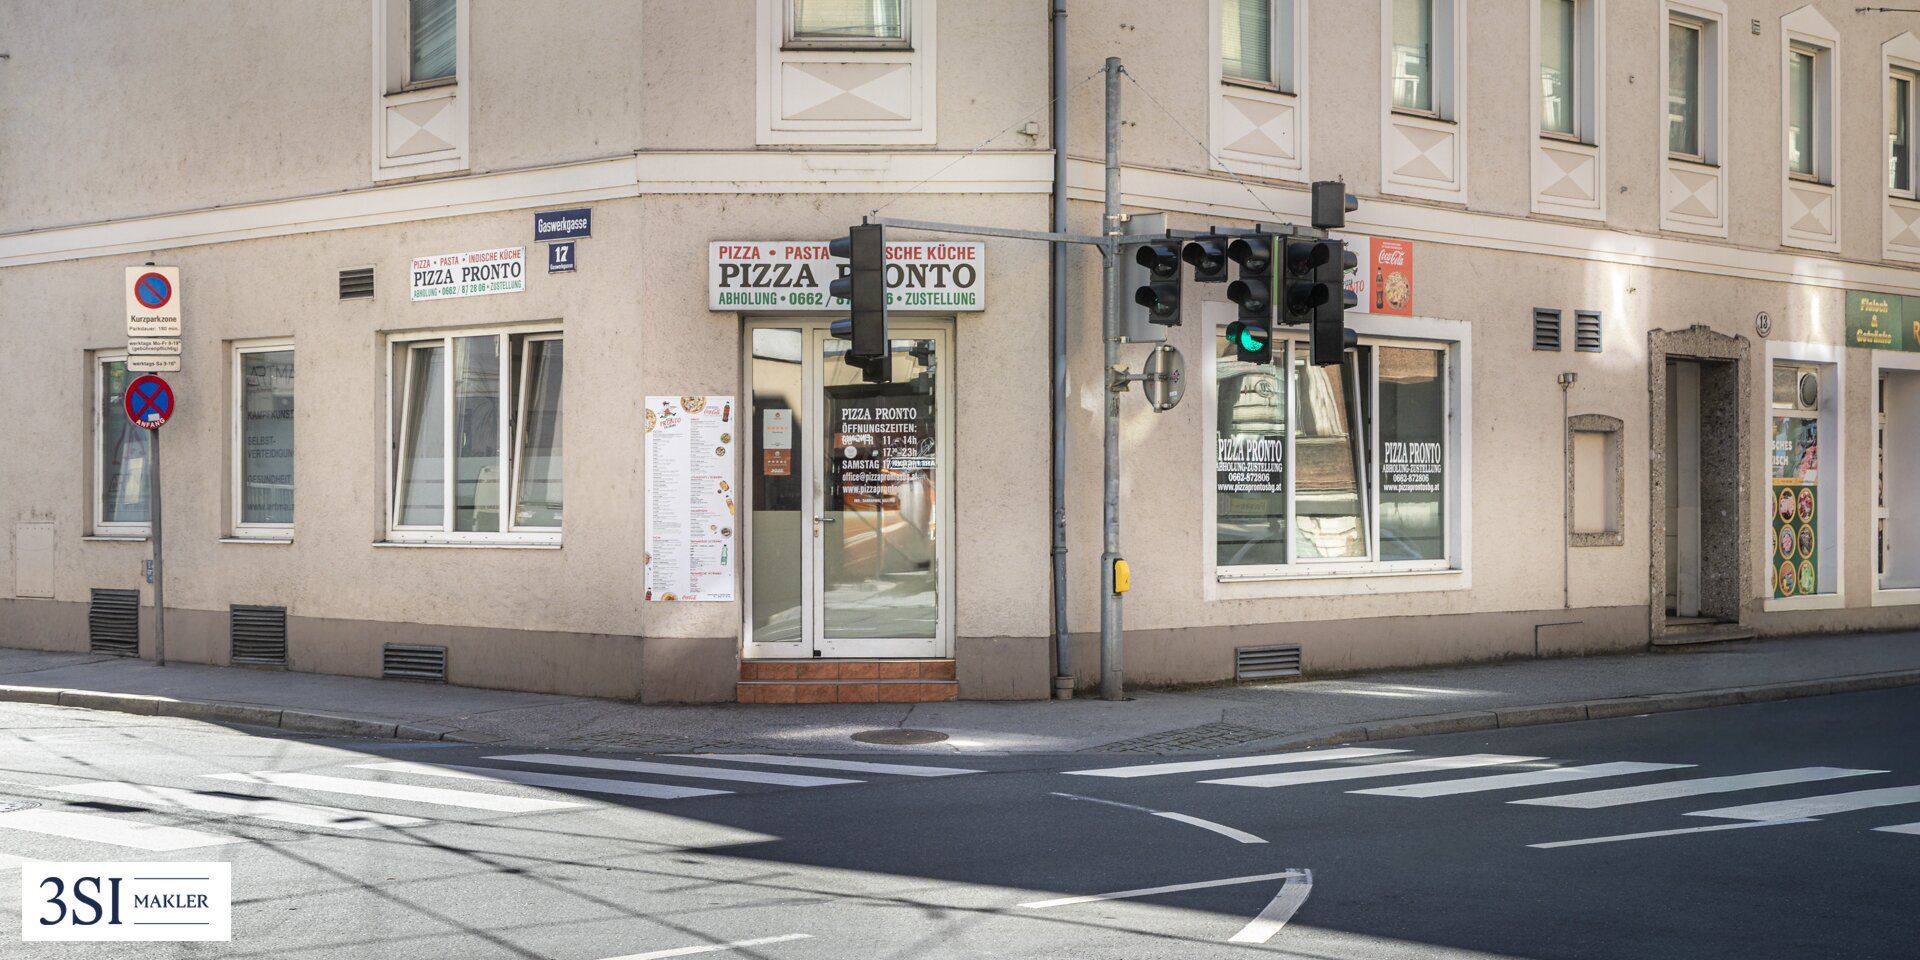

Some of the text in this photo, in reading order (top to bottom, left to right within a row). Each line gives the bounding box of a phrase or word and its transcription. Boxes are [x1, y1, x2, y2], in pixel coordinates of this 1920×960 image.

[538, 217, 587, 233] Gaswerkgasse
[555, 246, 568, 262] 17
[719, 244, 975, 260] PIZZA PASTA SCHE KÜCHE
[413, 249, 521, 269] PIZZA PASTA INDISCHE KÜCHE
[414, 261, 521, 287] PIZZA PRONTO
[719, 263, 976, 289] PIZZA PONTO
[414, 287, 437, 298] ABHOLUNG
[442, 286, 456, 296] 0662
[469, 284, 478, 293] 28
[478, 283, 486, 292] 06
[490, 280, 521, 291] ZUSTELLUNG
[719, 292, 777, 306] ABHOLUNG
[789, 293, 823, 306] 0662
[905, 292, 976, 306] ZUSTELLUNG
[131, 315, 177, 324] Kurzparkzone
[1760, 315, 1768, 329] 13
[842, 408, 917, 420] PIZZA PRONTO
[136, 417, 165, 428] ANFANG
[842, 422, 917, 433] ÖFFNUNGSZEITEN:
[247, 436, 276, 446] SELBST-
[882, 436, 891, 445] 11
[902, 436, 917, 445] 14h
[1772, 440, 1793, 451] SCHES
[247, 448, 294, 459] VERTEIDIGUN
[1218, 438, 1282, 462] PIZZA PRONTO
[1384, 442, 1441, 464] PIZZA PRONTO
[842, 460, 879, 469] SAMSTAG
[1216, 462, 1282, 472] ABHOLUNG-ZUSTELLUNG
[1382, 464, 1441, 473] ABHOLUNG-ZUSTELLUNG
[1228, 473, 1270, 482] 0662-872806
[1393, 474, 1430, 482] 0662-872806
[1218, 481, 1281, 493] www.pizzaprontosbg.at
[1384, 482, 1439, 493] www.pizzaprontosbg.at
